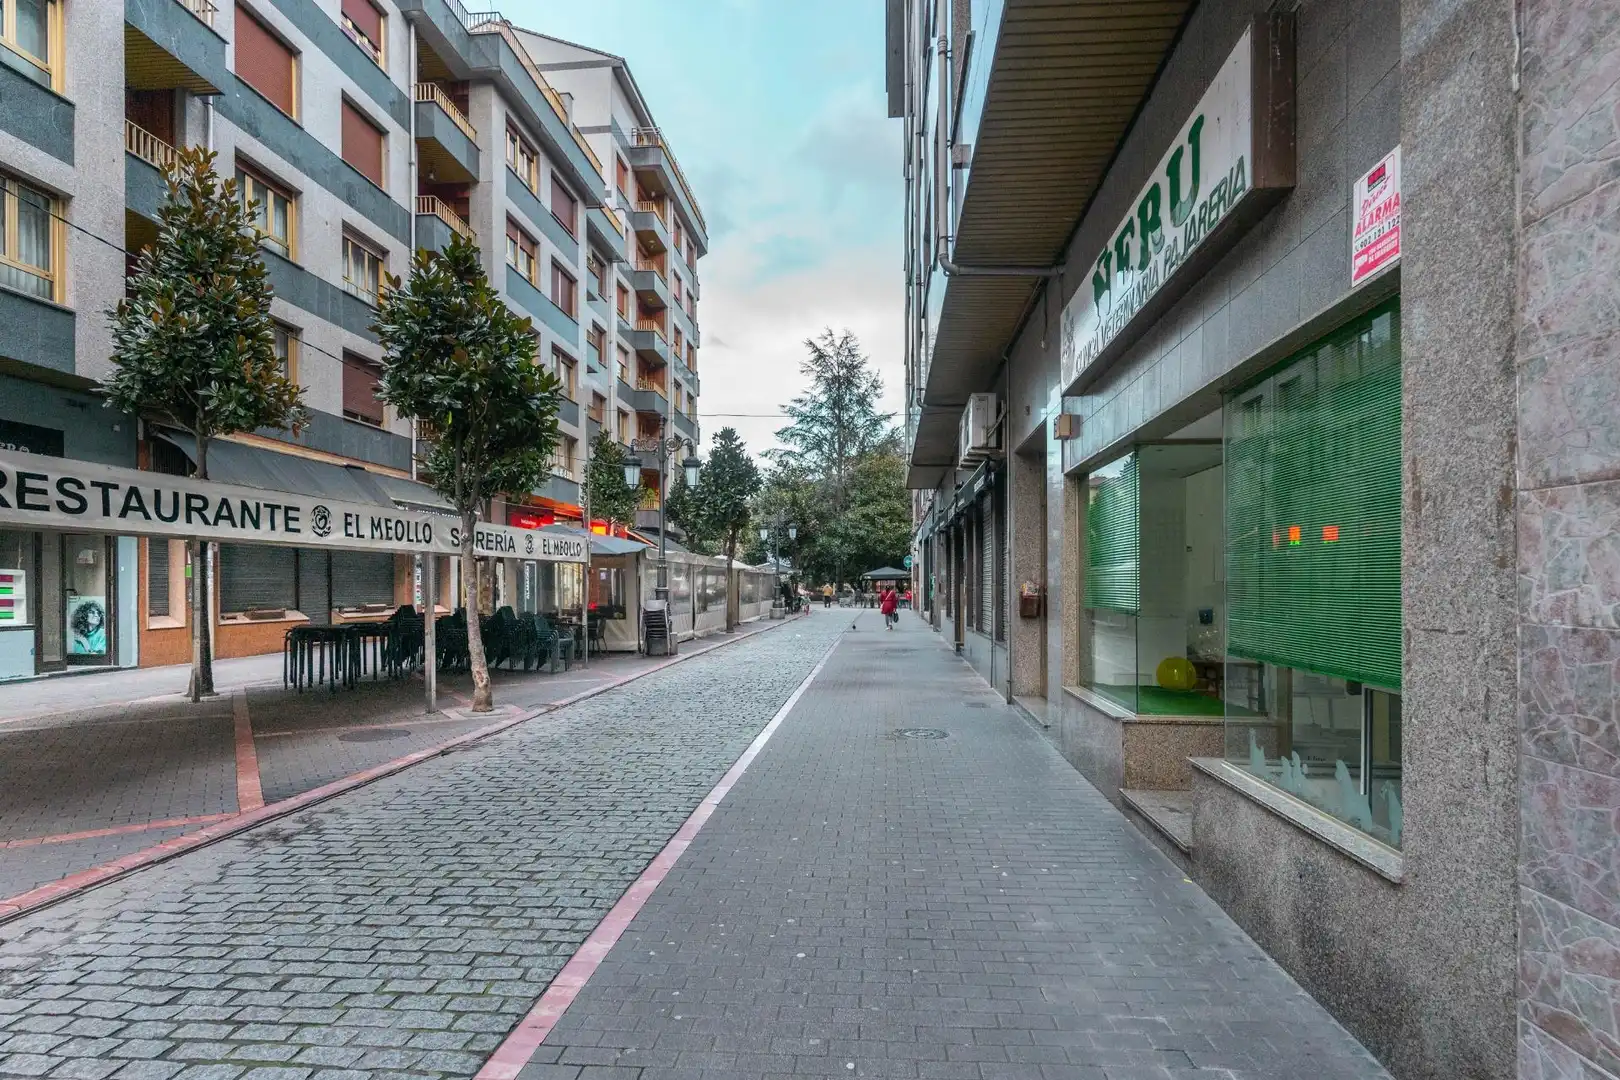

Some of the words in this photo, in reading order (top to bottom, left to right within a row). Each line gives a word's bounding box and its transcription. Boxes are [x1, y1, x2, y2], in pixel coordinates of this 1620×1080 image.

[1354, 192, 1400, 238] ALARMA
[1101, 259, 1159, 346] VETERINARIA
[1164, 155, 1246, 278] PAJARERIA
[344, 512, 365, 538] EL
[370, 516, 432, 544] MEOLLO
[450, 528, 516, 553] SRERÍA
[543, 538, 551, 555] EL
[553, 540, 582, 557] MEOLLO
